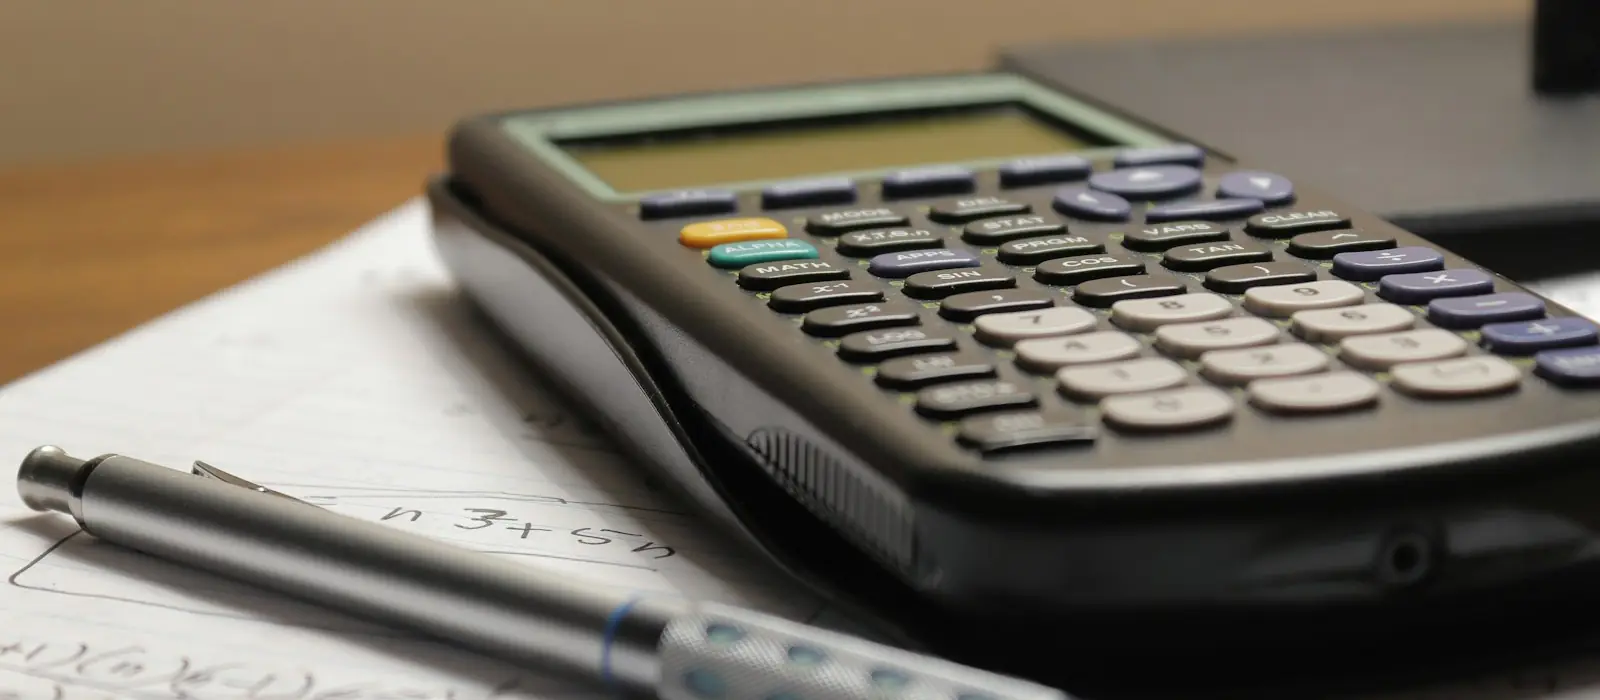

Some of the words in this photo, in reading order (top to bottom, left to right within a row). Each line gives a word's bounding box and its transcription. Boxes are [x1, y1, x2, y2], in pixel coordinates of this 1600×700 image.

[822, 208, 894, 221] MODE
[1262, 210, 1338, 225] CLEAR
[983, 216, 1045, 229] STAT
[1143, 223, 1212, 235] VARS
[725, 240, 801, 254] ALPHA
[1012, 236, 1089, 250] PRGM
[1188, 243, 1245, 255] TAN
[897, 250, 955, 261] APPS
[755, 262, 832, 274] MATH
[1062, 256, 1118, 268] COS
[937, 270, 982, 280] SIN
[1018, 314, 1041, 325] 7
